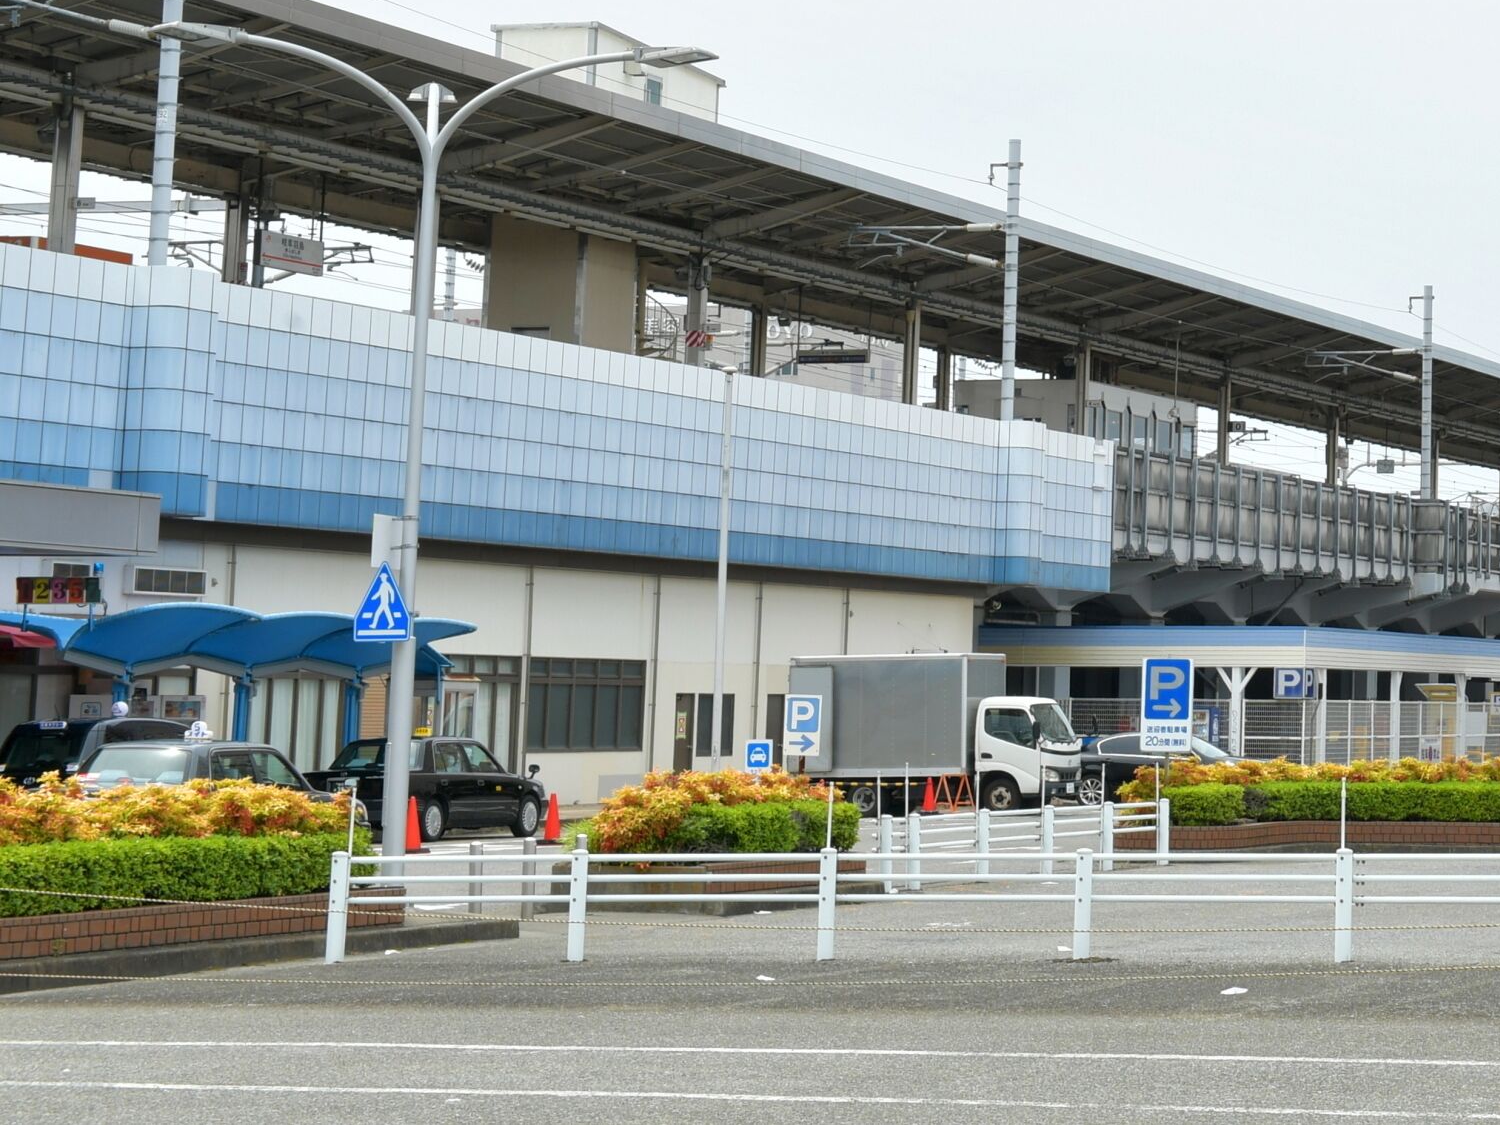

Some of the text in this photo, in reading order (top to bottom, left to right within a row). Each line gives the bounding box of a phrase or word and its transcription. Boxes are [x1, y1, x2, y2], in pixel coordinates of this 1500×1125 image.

[36, 581, 49, 600] 2
[54, 581, 66, 600] 3
[1149, 665, 1185, 700] P
[1277, 669, 1301, 696] P
[791, 700, 815, 730] P
